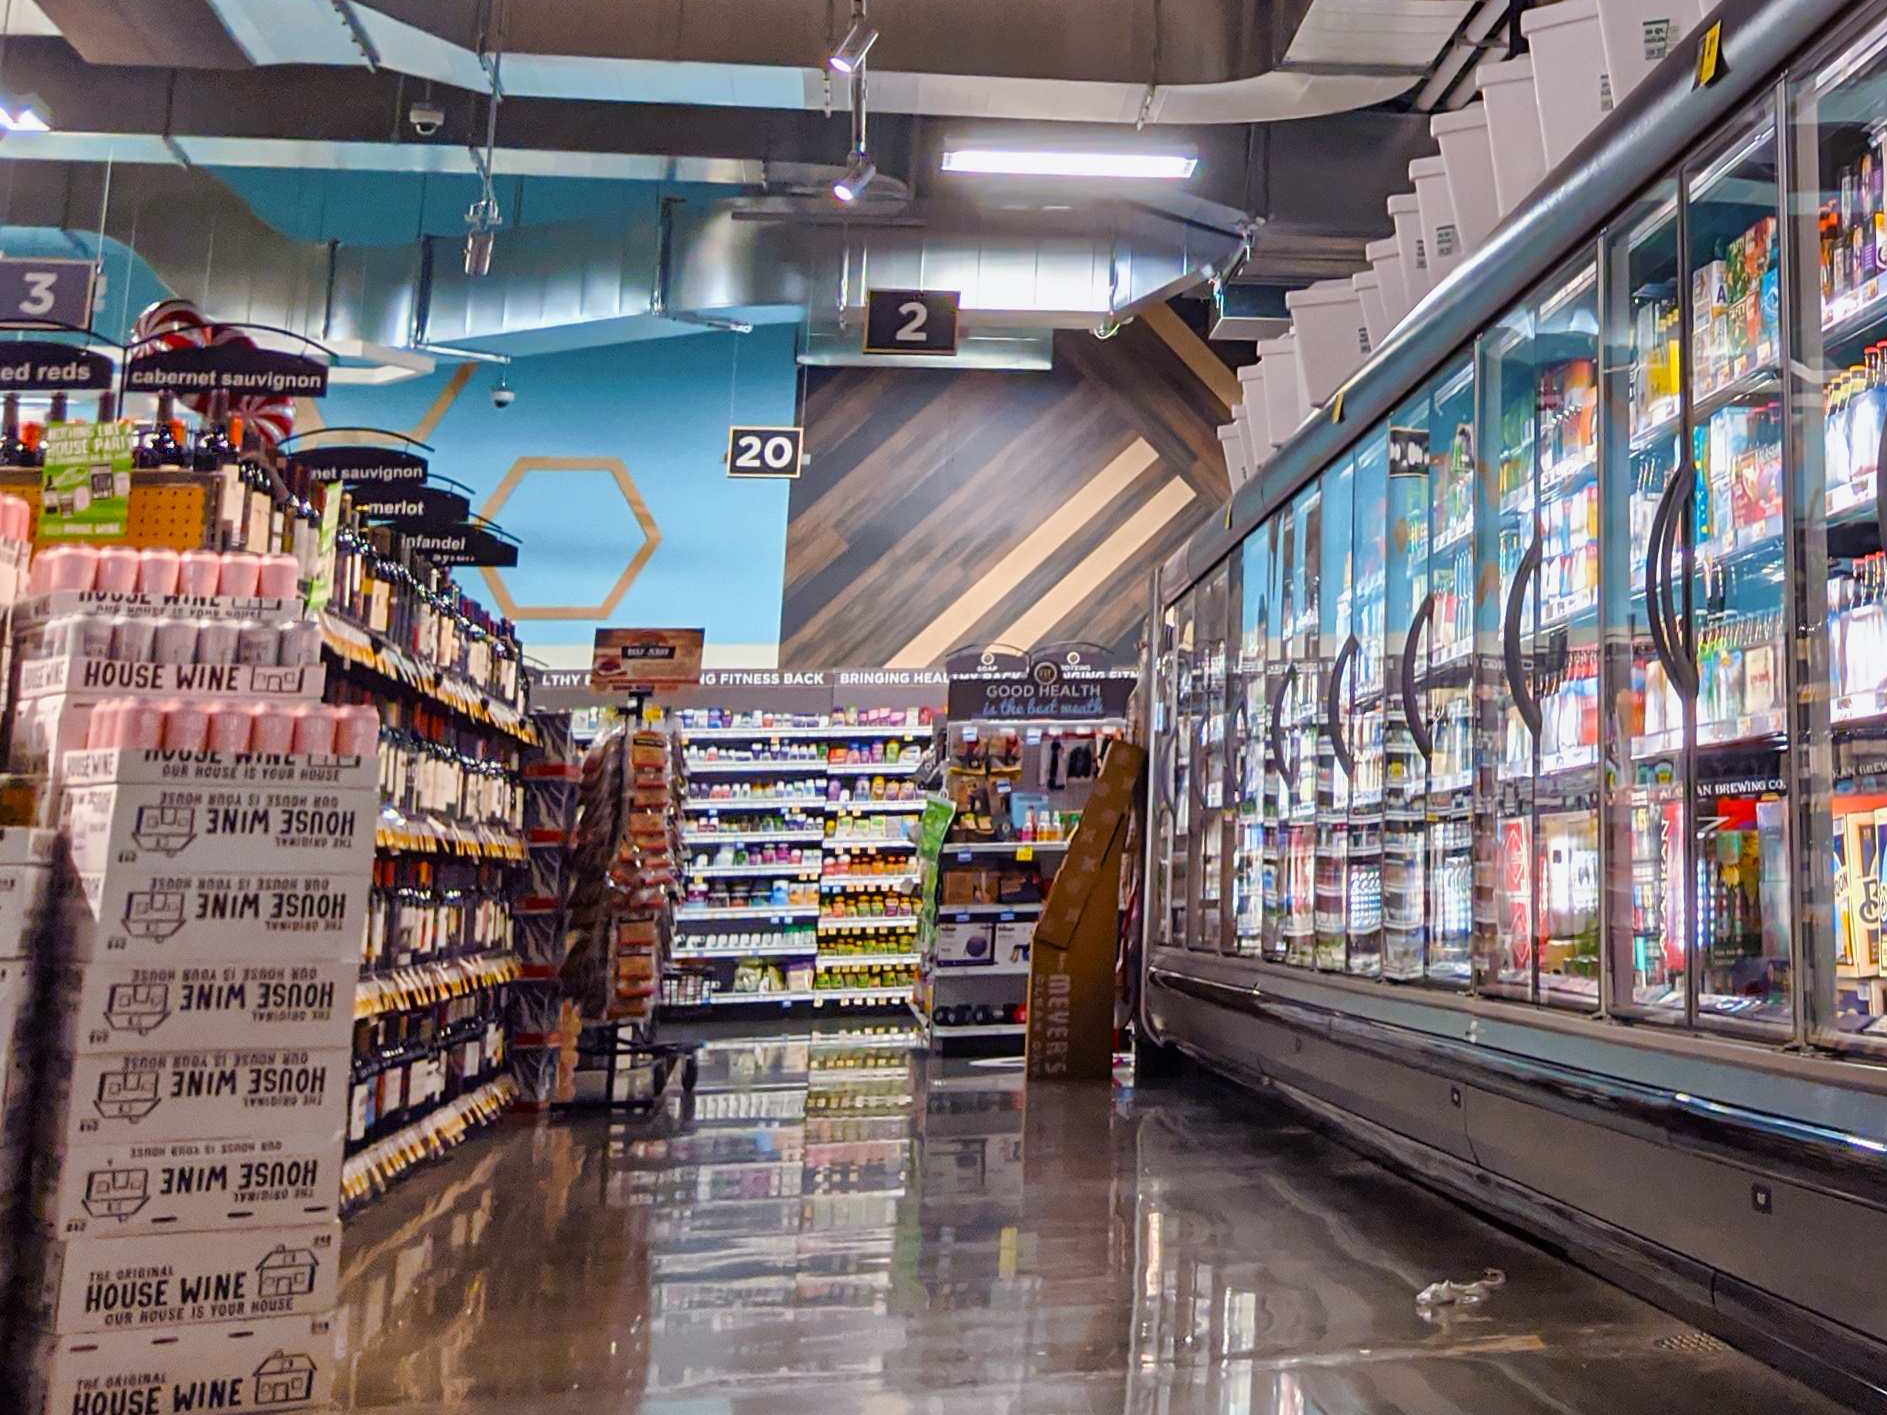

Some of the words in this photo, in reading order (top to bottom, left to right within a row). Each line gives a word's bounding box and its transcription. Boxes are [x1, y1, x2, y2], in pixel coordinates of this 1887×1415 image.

[20, 271, 58, 315] 3
[894, 301, 929, 342] 2
[37, 362, 91, 381] reds
[132, 368, 217, 385] cabernet
[221, 369, 322, 390] sauvignon
[735, 436, 793, 468] 20
[341, 466, 424, 482] sauvignon
[368, 501, 425, 516] merlot
[402, 535, 467, 551] infandel
[83, 660, 165, 688] HOUSE
[175, 665, 241, 691] WINE
[720, 672, 781, 685] FITNESS
[784, 672, 824, 685] BACK
[840, 672, 909, 685] BRINGING
[986, 685, 1035, 698] GOOD
[1039, 684, 1100, 698] HEALTH
[1000, 697, 1024, 715] the
[163, 765, 188, 778] OUR
[195, 765, 238, 779] HOUSE
[243, 766, 257, 779] IS
[262, 766, 295, 780] YOUR
[300, 767, 341, 781] HOUSE
[1715, 780, 1767, 795] BREWING
[160, 792, 202, 805] HOUSE
[208, 793, 242, 806] YOUR
[247, 794, 261, 807] IS
[267, 794, 308, 808] HOUSE
[314, 795, 339, 809] OUR
[206, 809, 270, 834] WINE
[280, 810, 355, 836] HOUSE
[275, 836, 328, 847] ORIGINAL
[333, 836, 352, 848] THE
[196, 893, 260, 919] WINE
[270, 893, 347, 919] HOUSE
[266, 920, 319, 931] ORIGINAL
[324, 920, 343, 932] THE
[133, 969, 176, 982] HOUSE
[182, 969, 217, 981] YOUR
[224, 969, 236, 981] IS
[243, 968, 285, 980] HOUSE
[291, 968, 317, 980] OUR
[180, 984, 246, 1011] WINE
[257, 982, 334, 1008] HOUSE
[252, 1010, 306, 1022] ORIGINAL
[312, 1009, 330, 1021] THE
[123, 1057, 166, 1069] HOUSE
[172, 1057, 208, 1068] YOUR
[214, 1056, 227, 1067] IS
[234, 1054, 276, 1066] HOUSE
[282, 1053, 308, 1065] OUR
[170, 1070, 237, 1097] WINE
[248, 1066, 326, 1094] HOUSE
[243, 1097, 298, 1108] ORIGINAL
[302, 1095, 322, 1106] THE
[160, 1165, 227, 1195] WINE
[240, 1159, 318, 1189] HOUSE
[234, 1190, 289, 1203] ORIGINAL
[293, 1188, 314, 1199] THE
[89, 1271, 110, 1283] THE
[116, 1266, 174, 1279] ORIGINAL
[85, 1280, 168, 1313] HOUSE
[180, 1272, 247, 1305] WINE
[104, 1313, 133, 1326] OUR
[140, 1307, 184, 1323] HOUSE
[191, 1306, 204, 1319] IS
[210, 1303, 245, 1318] YOUR
[251, 1298, 294, 1313] HOUSE
[76, 1377, 99, 1390] THE
[106, 1373, 167, 1386] ORIGINAL
[73, 1386, 162, 1415] HOUSE
[173, 1378, 243, 1413] WINE
